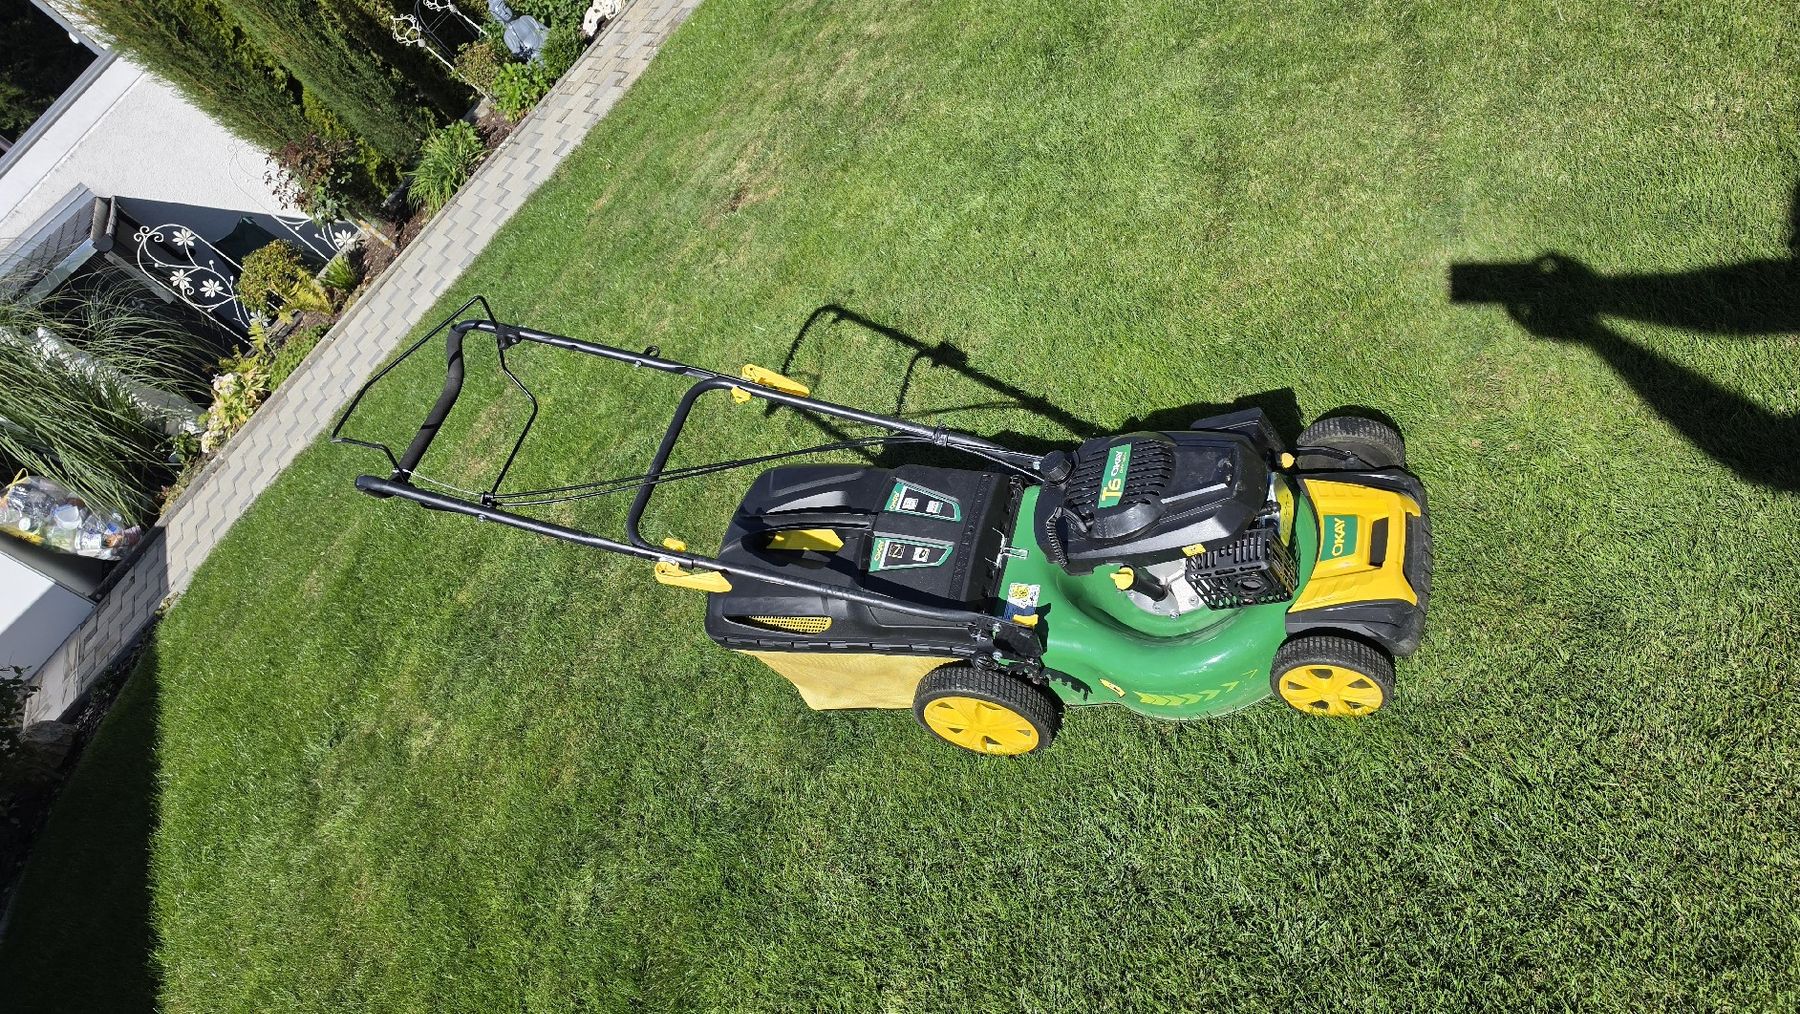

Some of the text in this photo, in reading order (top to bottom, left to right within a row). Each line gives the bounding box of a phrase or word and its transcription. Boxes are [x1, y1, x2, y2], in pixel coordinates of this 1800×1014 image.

[1101, 450, 1123, 501] T6 OKAY
[874, 540, 885, 561] OKAY
[1332, 517, 1345, 556] OKAY
